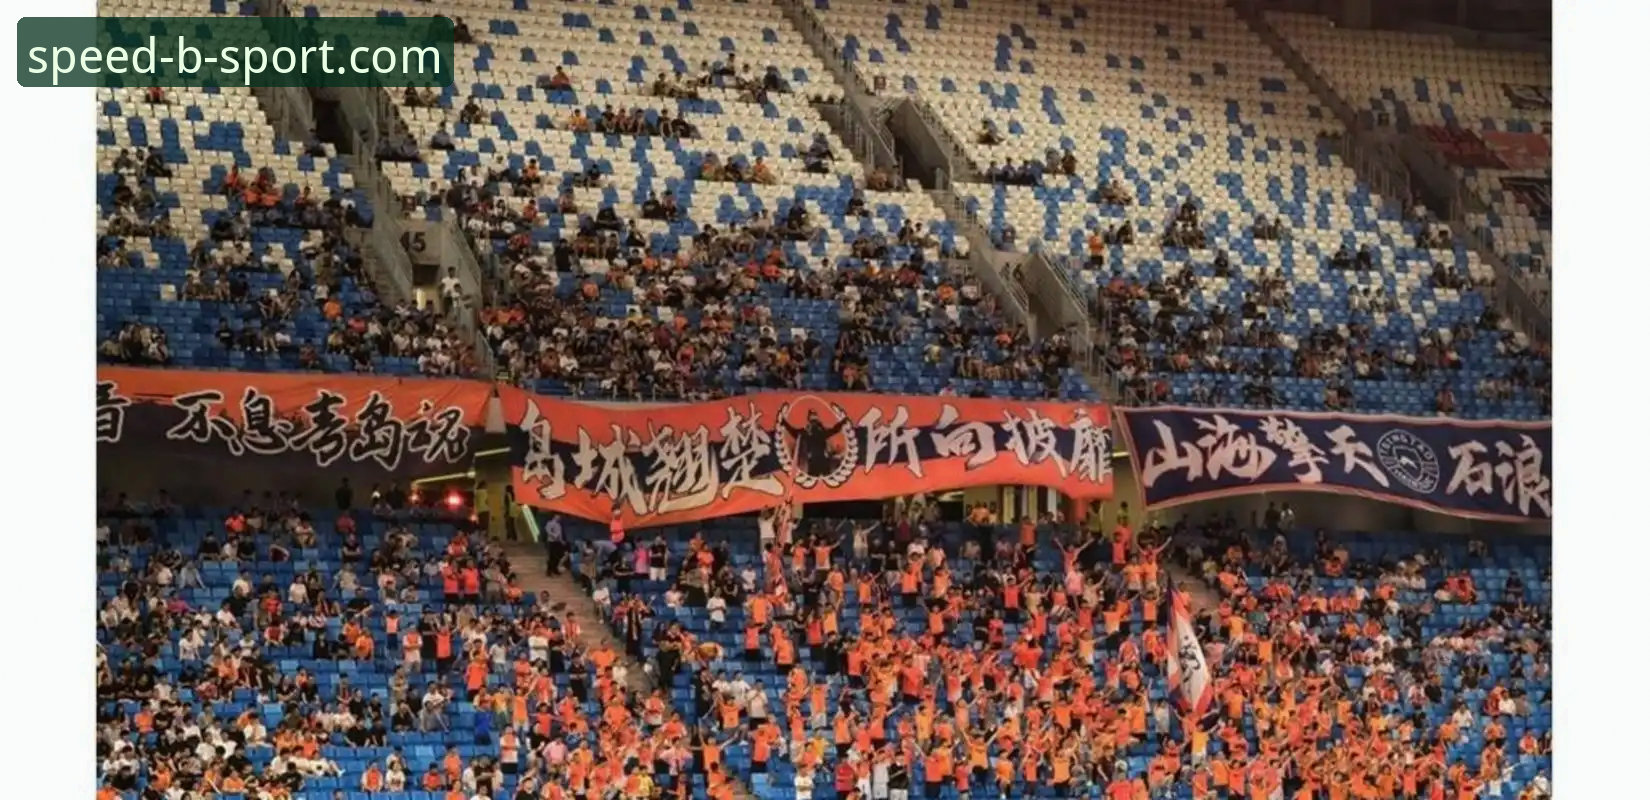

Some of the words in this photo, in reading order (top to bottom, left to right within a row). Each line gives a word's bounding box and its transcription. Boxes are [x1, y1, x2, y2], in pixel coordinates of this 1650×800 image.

[857, 404, 1112, 485] 所向披靡
[1143, 413, 1390, 488] 山海擎天
